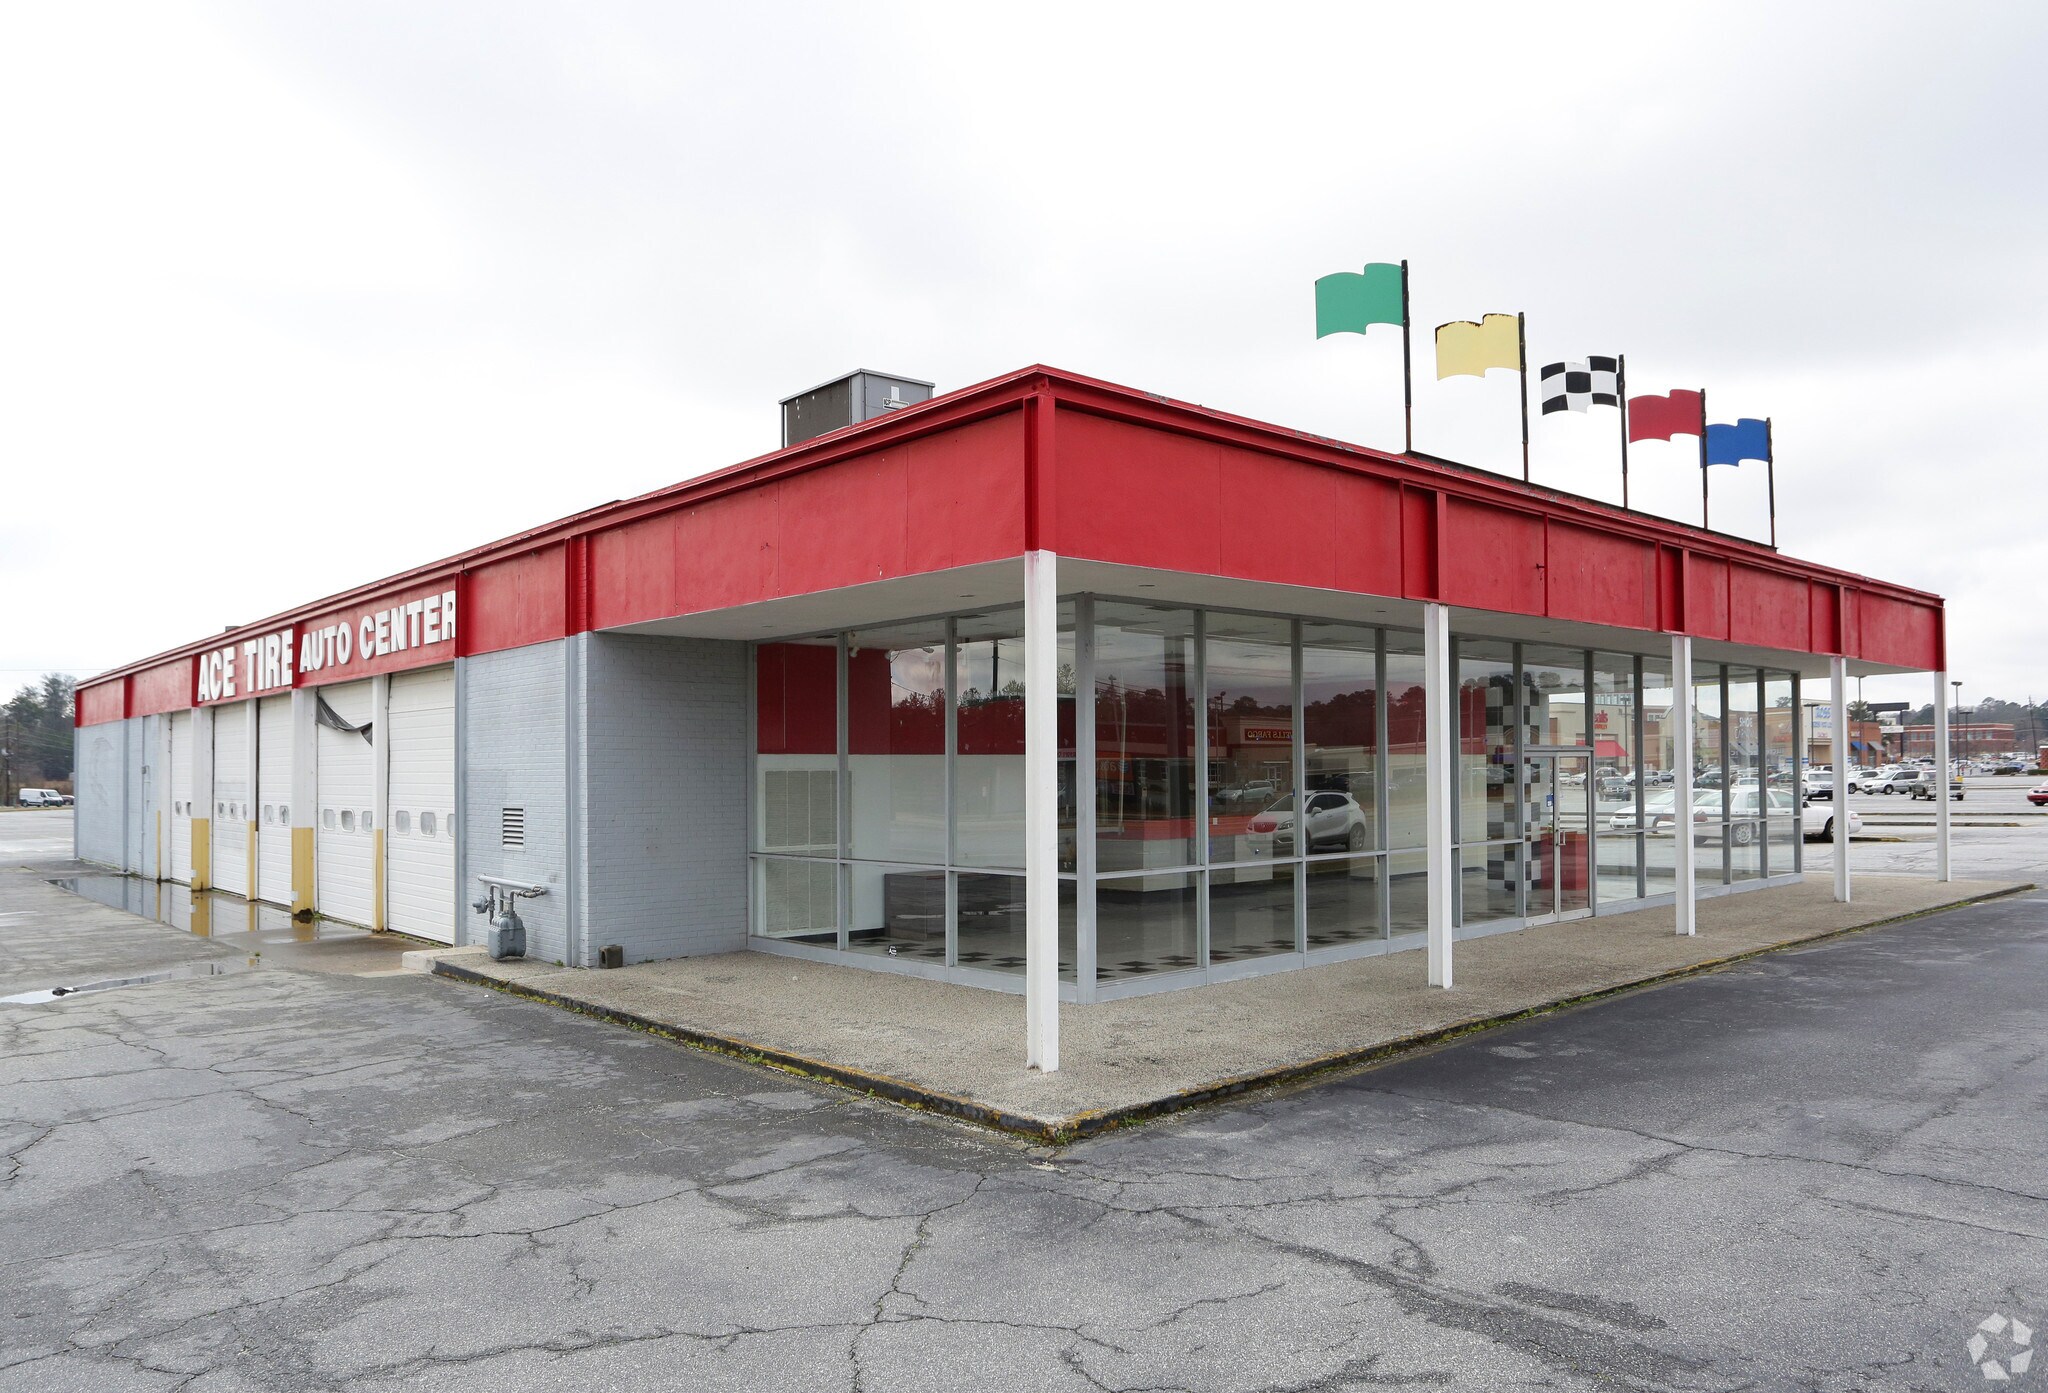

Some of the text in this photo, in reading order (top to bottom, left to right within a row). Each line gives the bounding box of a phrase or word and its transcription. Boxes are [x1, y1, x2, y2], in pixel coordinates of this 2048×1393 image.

[198, 590, 456, 702] ACE TIRE AUTO CENTER
